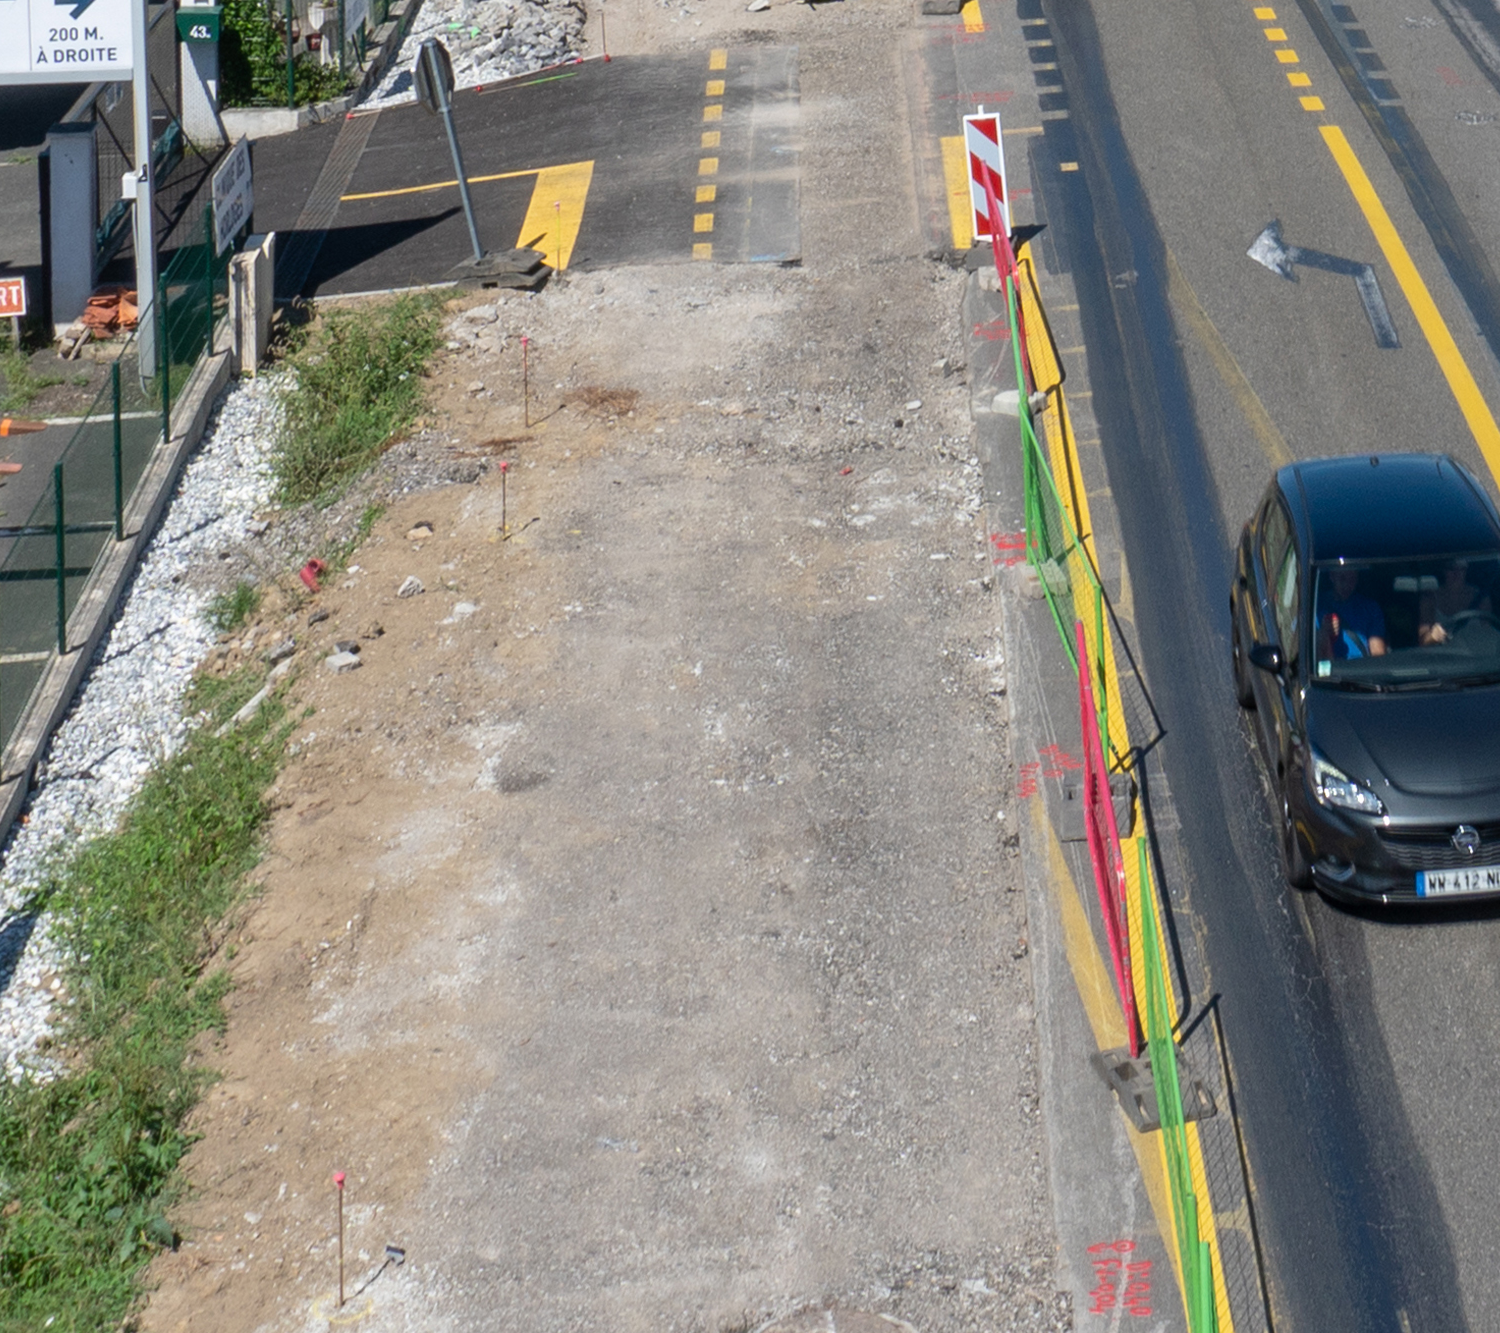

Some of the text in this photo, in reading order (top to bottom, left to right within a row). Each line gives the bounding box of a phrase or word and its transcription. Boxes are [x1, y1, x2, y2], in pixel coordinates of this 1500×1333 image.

[49, 26, 104, 42] 200 M.
[36, 46, 118, 64] À DROITE
